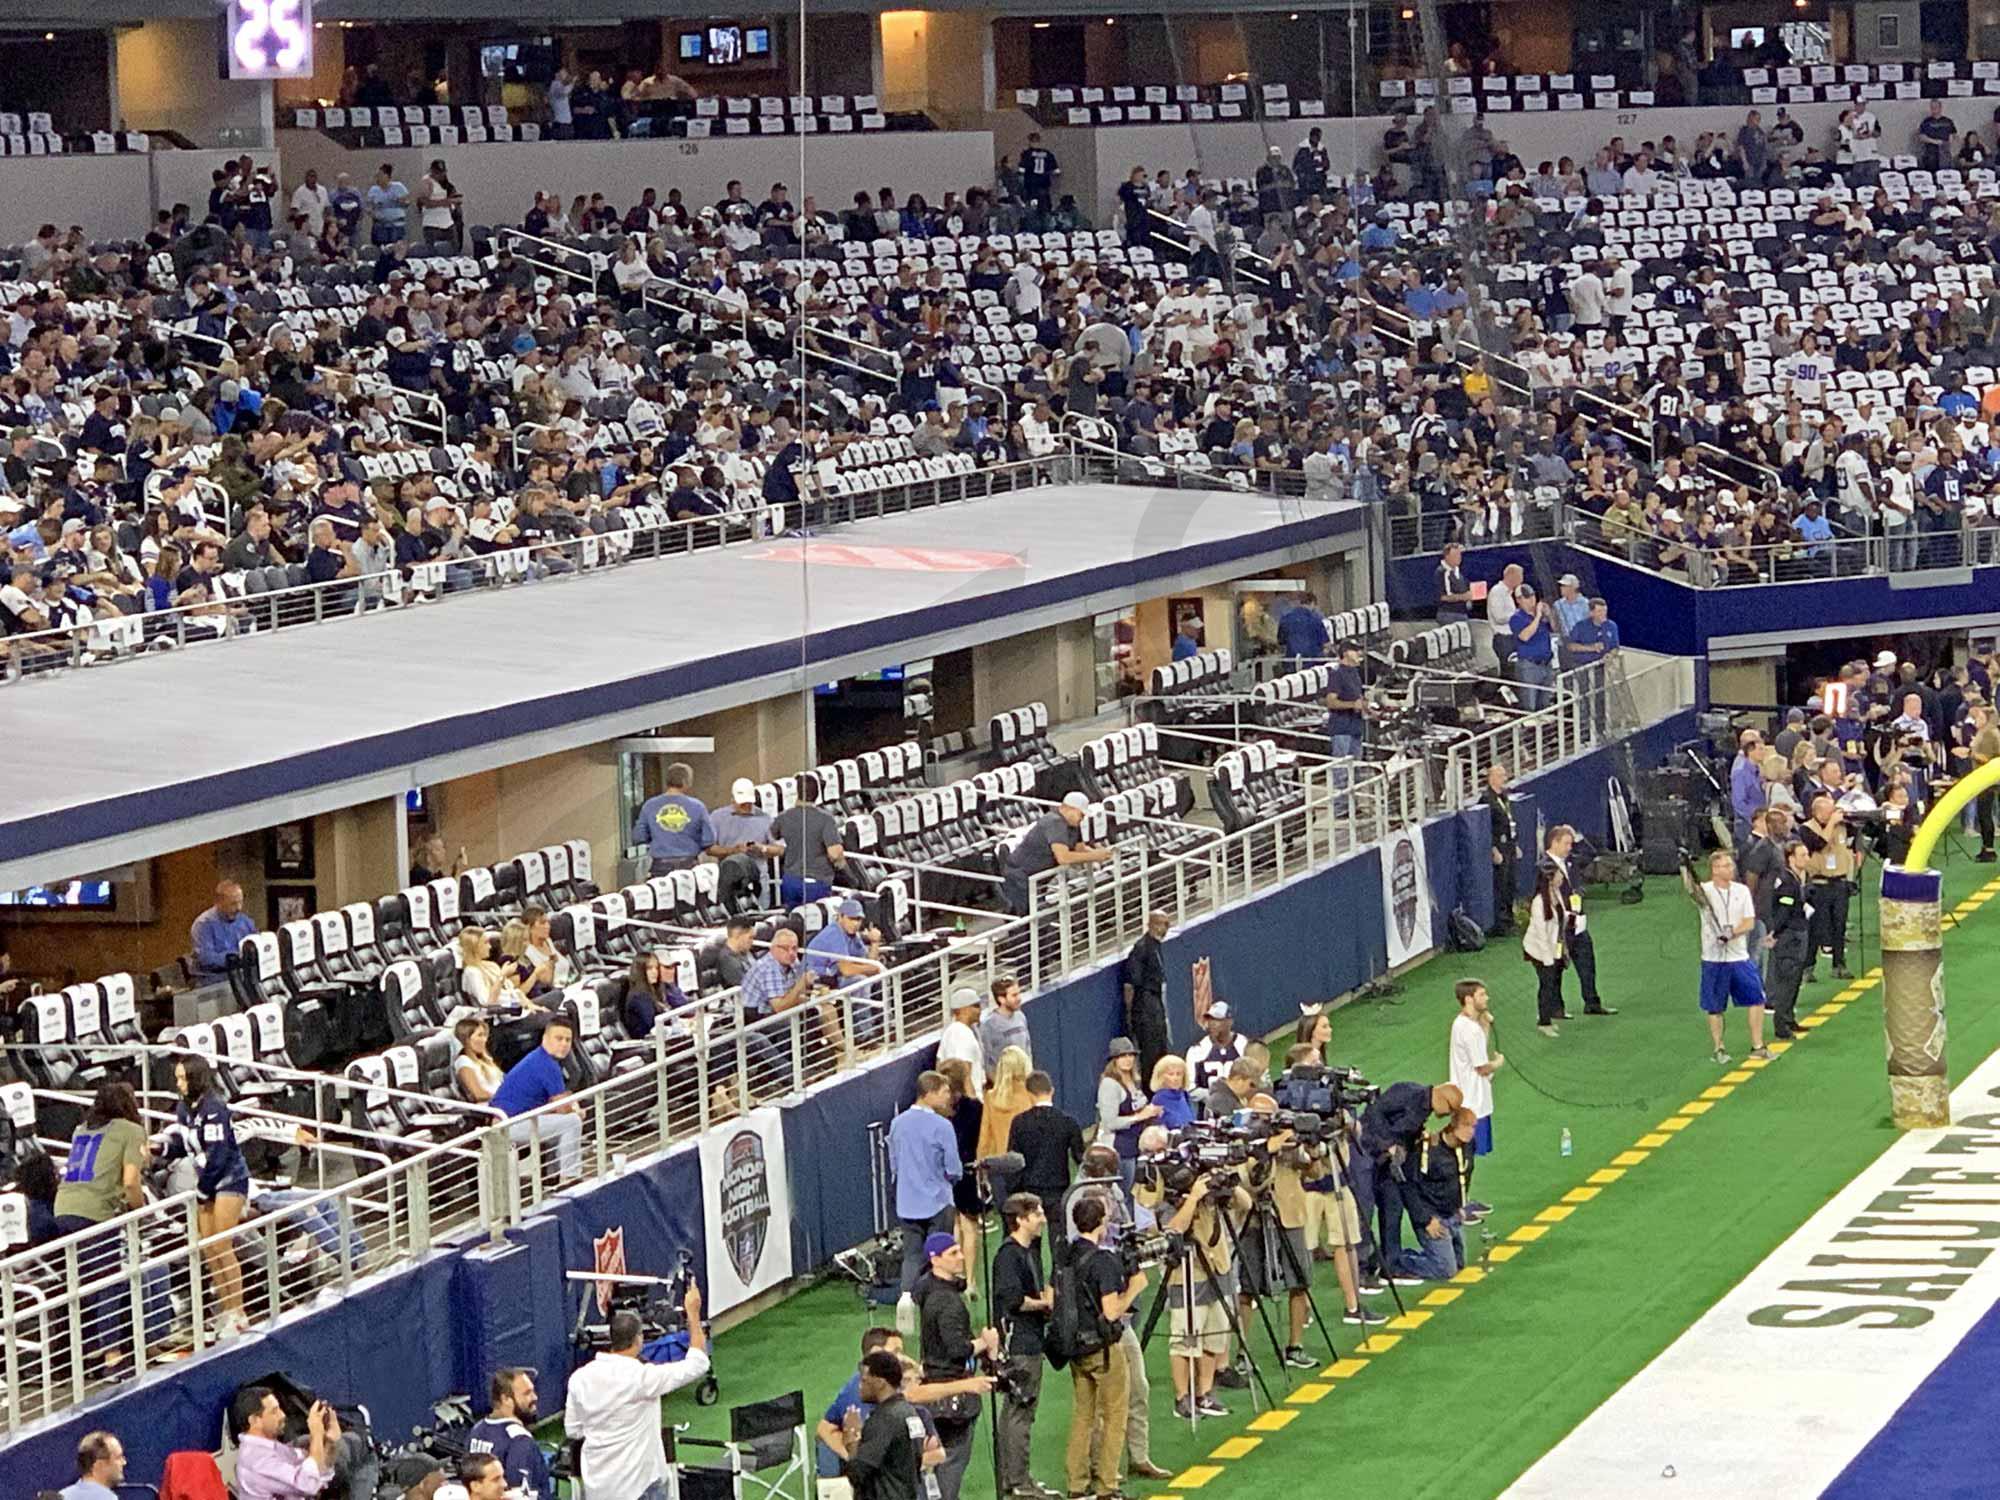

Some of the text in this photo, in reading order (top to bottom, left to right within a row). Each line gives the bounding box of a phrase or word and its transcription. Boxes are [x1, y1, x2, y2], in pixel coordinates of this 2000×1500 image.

[1617, 114, 1637, 125] 127
[1673, 289, 1696, 304] 84
[1798, 364, 1817, 380] 90
[1659, 395, 1679, 417] 81
[1944, 479, 1960, 501] 19
[728, 1178, 761, 1206] NIGHT
[720, 1193, 770, 1227] FOOTBALL
